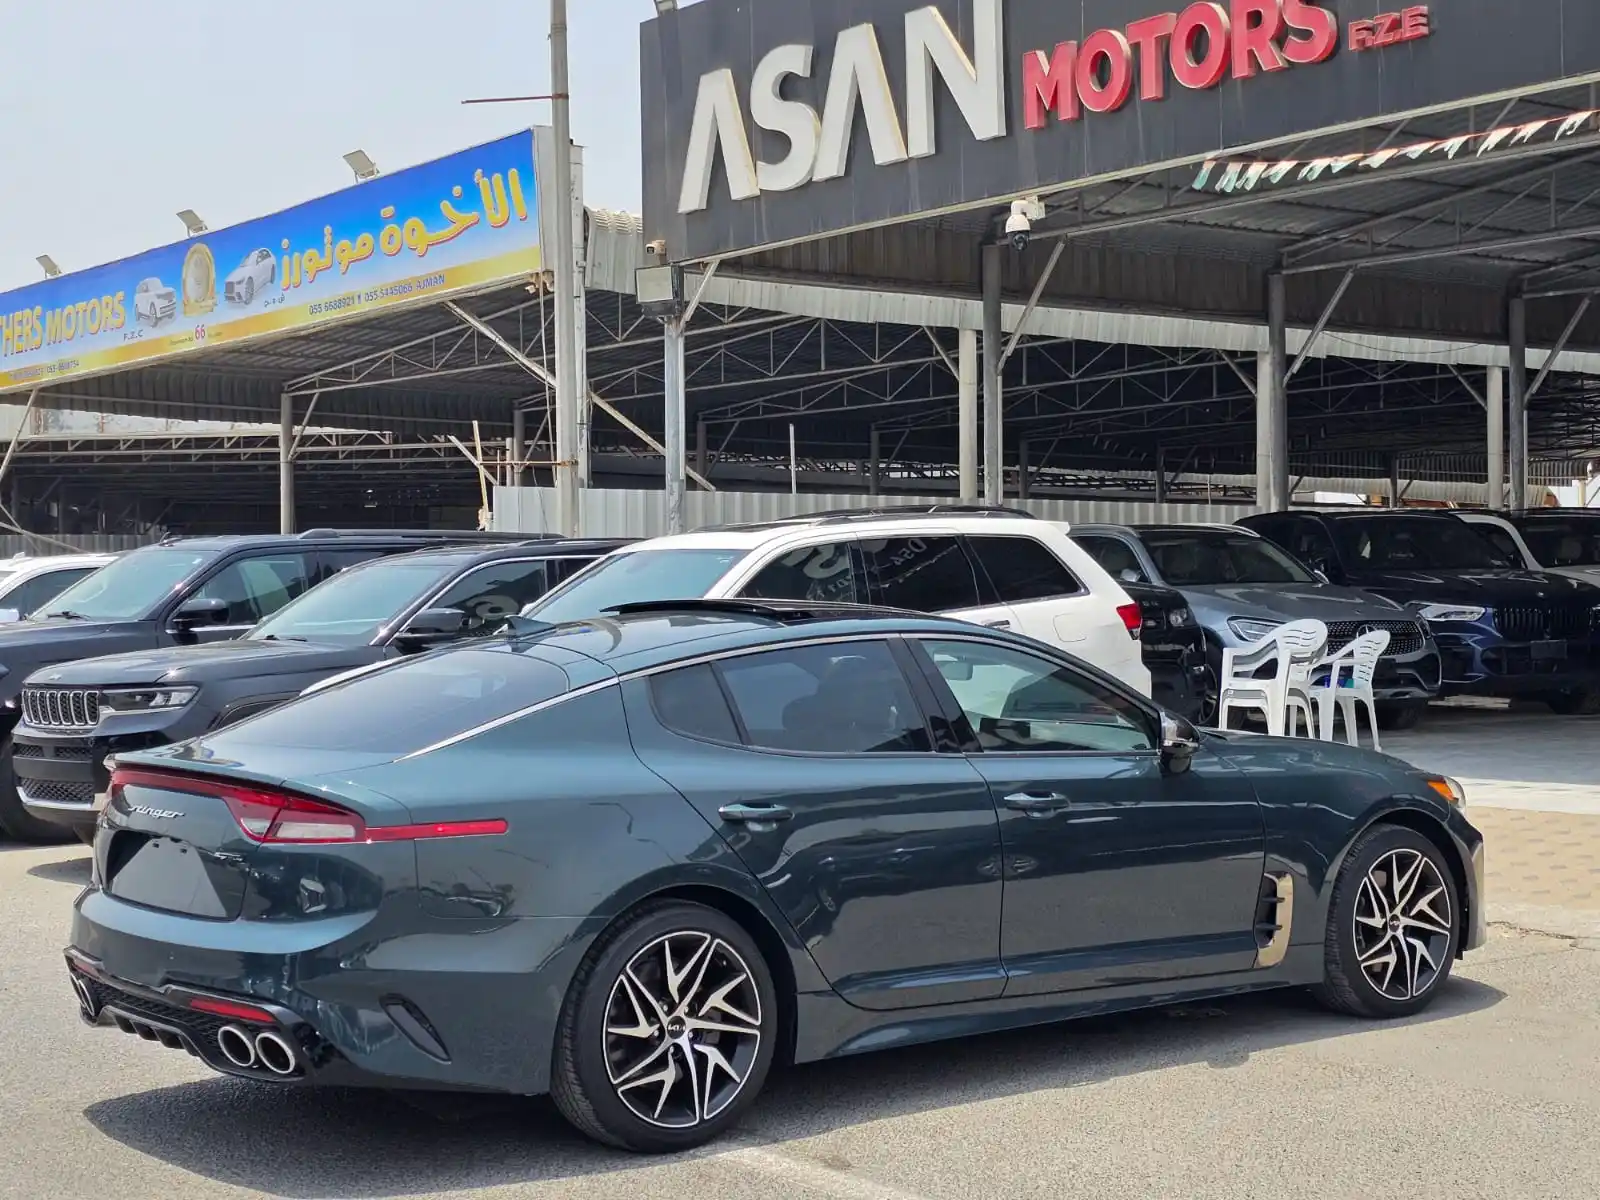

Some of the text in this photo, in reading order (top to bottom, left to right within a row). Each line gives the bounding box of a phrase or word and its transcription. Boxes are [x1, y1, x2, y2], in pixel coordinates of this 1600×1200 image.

[677, 0, 1008, 214] ASAN
[1023, 0, 1338, 130] MOTORS
[416, 274, 445, 292] AJMAN
[46, 292, 125, 345] MOTORS
[195, 324, 206, 340] 66
